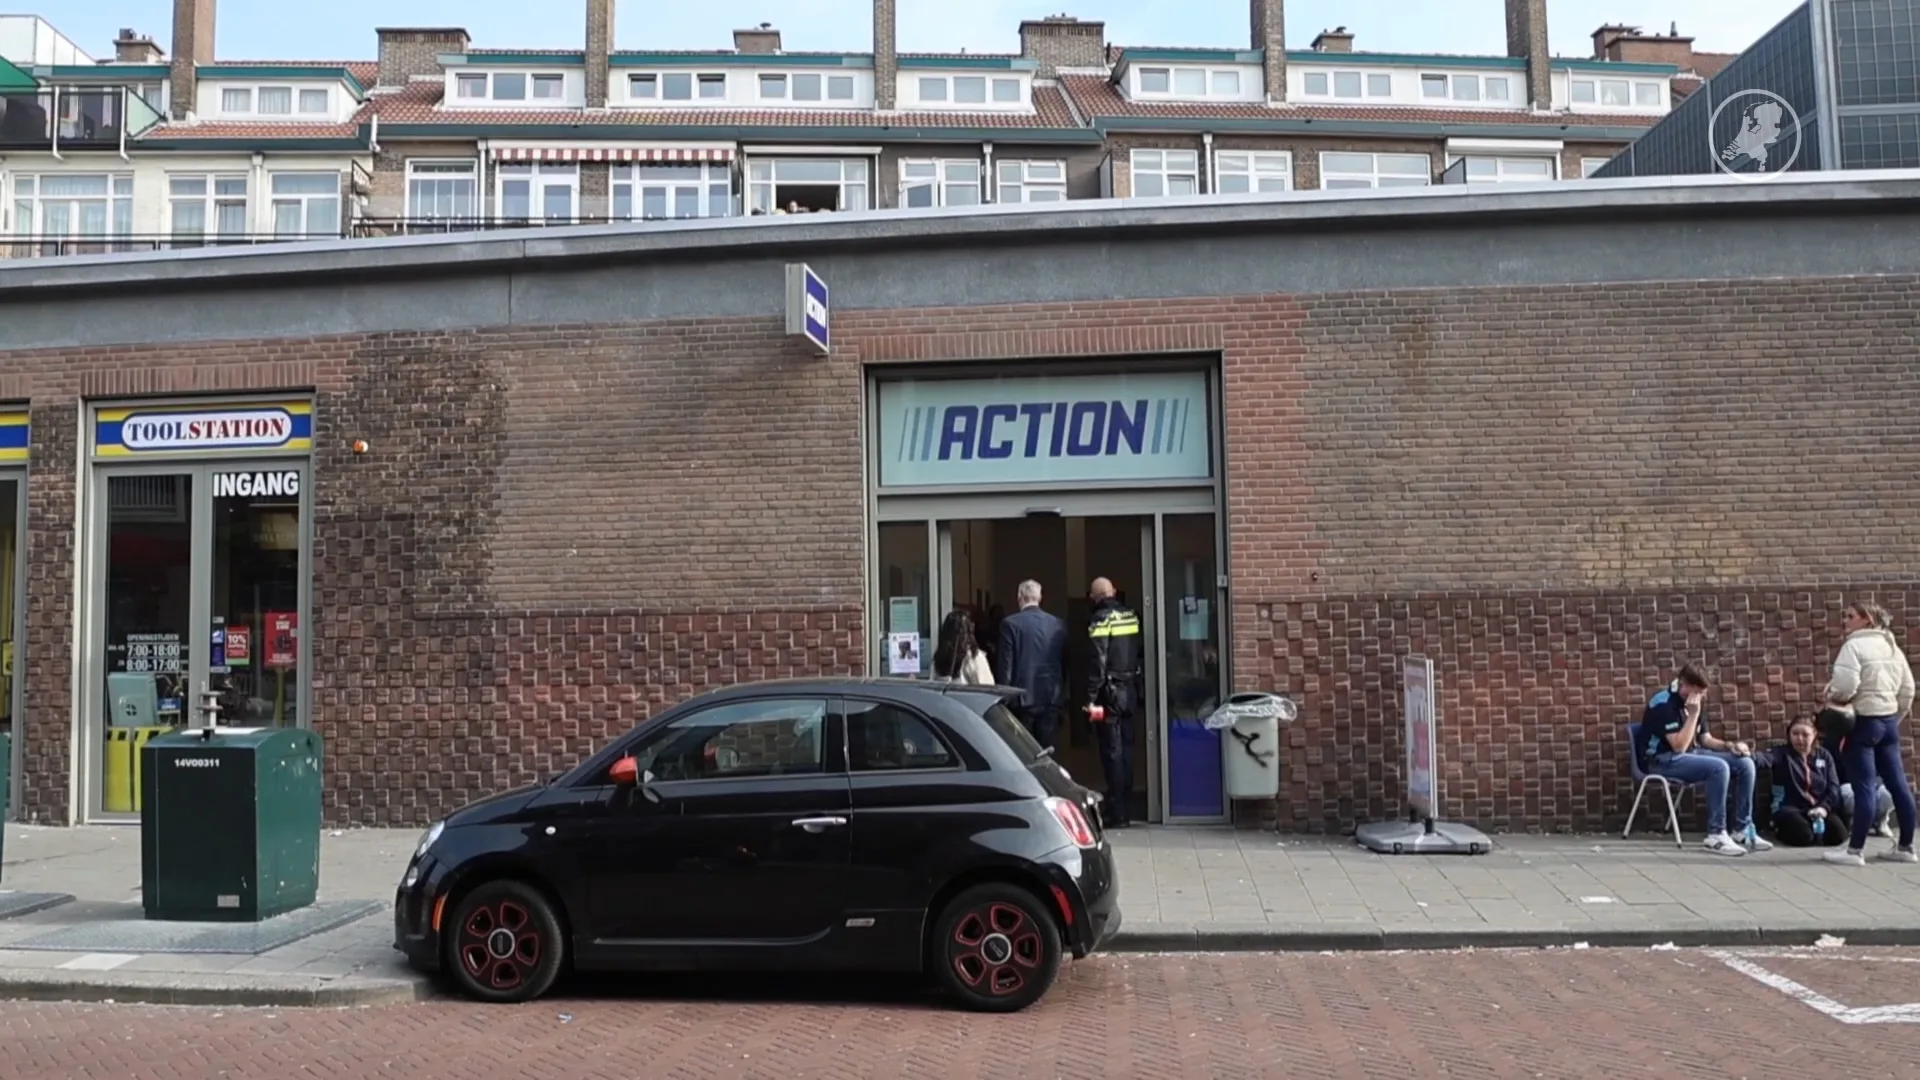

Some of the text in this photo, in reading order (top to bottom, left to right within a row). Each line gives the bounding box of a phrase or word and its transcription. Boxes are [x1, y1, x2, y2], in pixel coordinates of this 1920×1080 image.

[128, 418, 285, 442] TOOLSTATION
[938, 399, 1149, 461] ACTION
[213, 472, 299, 497] INGANG
[227, 635, 246, 645] 10%
